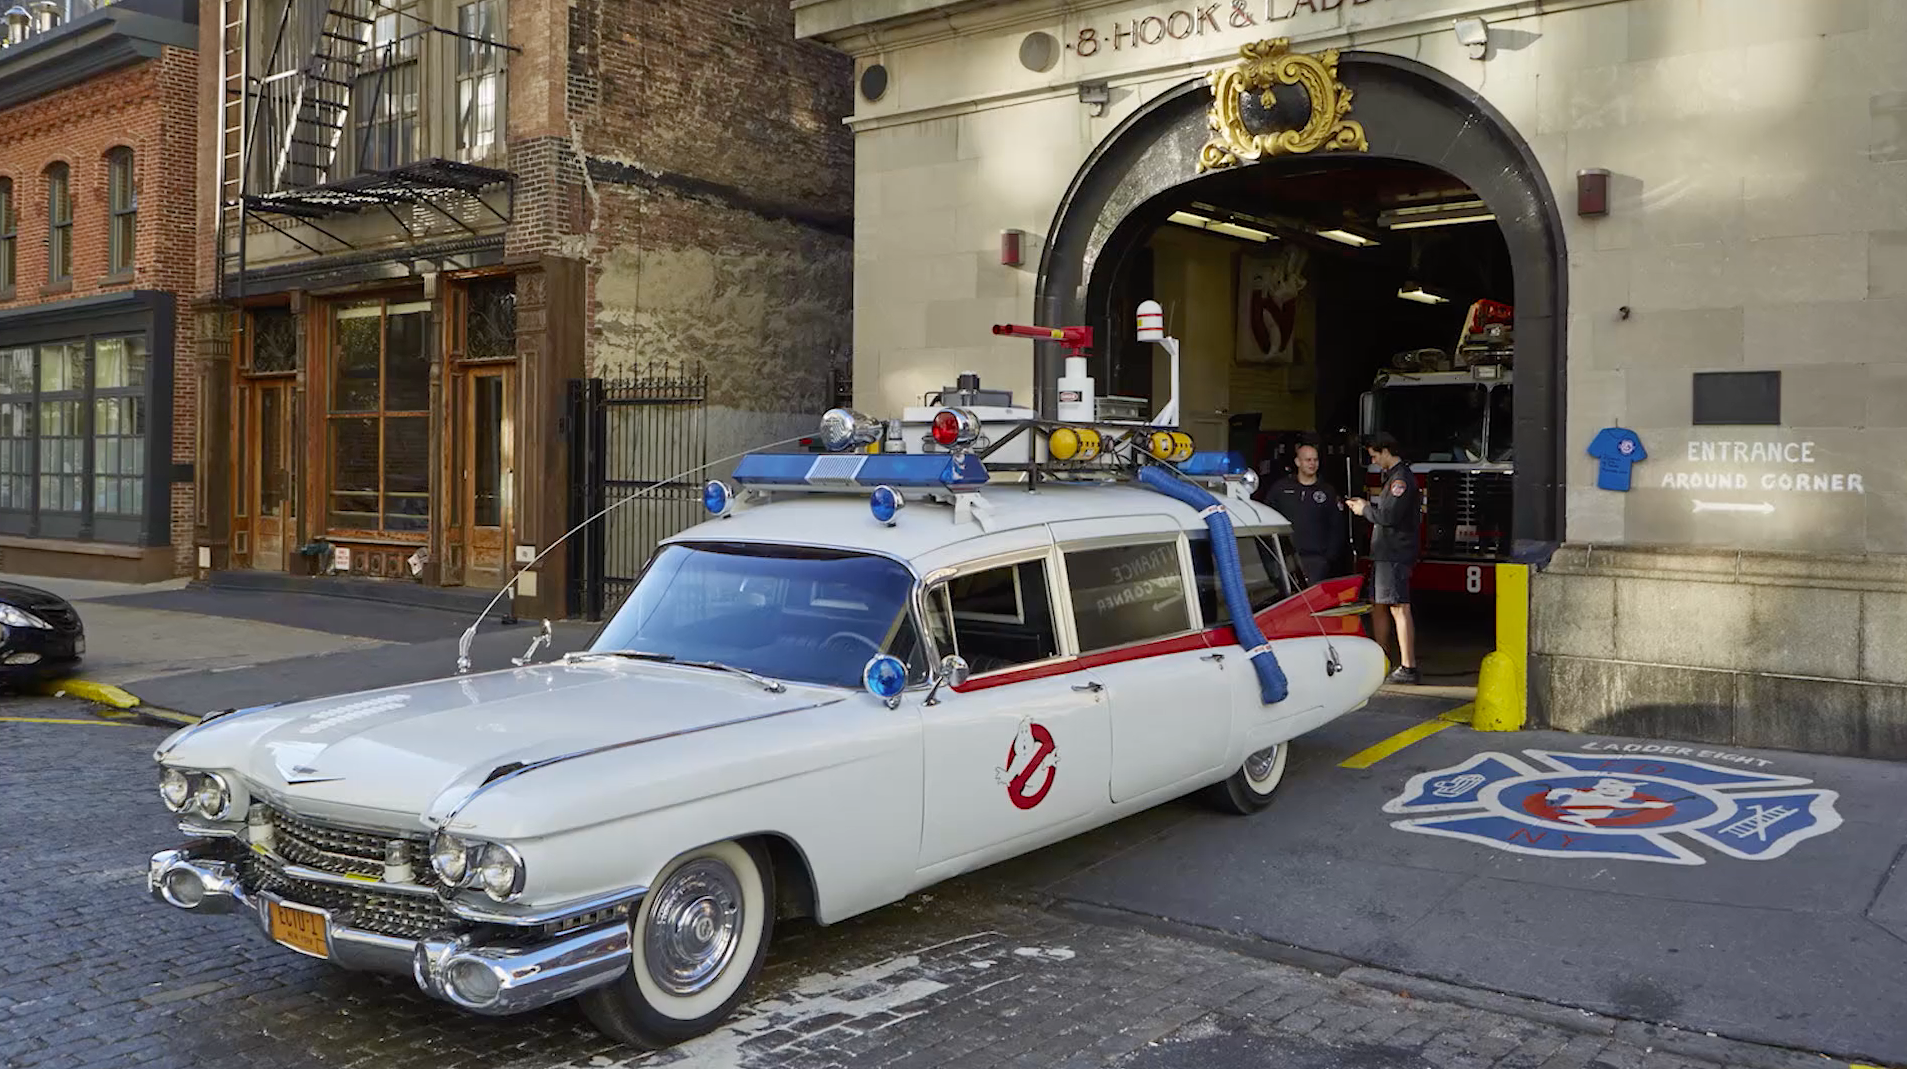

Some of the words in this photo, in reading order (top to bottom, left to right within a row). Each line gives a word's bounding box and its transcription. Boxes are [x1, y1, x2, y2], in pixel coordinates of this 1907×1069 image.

[1113, 3, 1221, 51] HOOK
[1228, 0, 1258, 28] &
[1688, 442, 1815, 463] ENTRANCE
[1661, 472, 1748, 490] AROUND
[1760, 473, 1865, 494] CORNER
[1467, 566, 1482, 593] 8
[1580, 741, 1694, 757] LADDER
[1697, 749, 1774, 768] EIGHT
